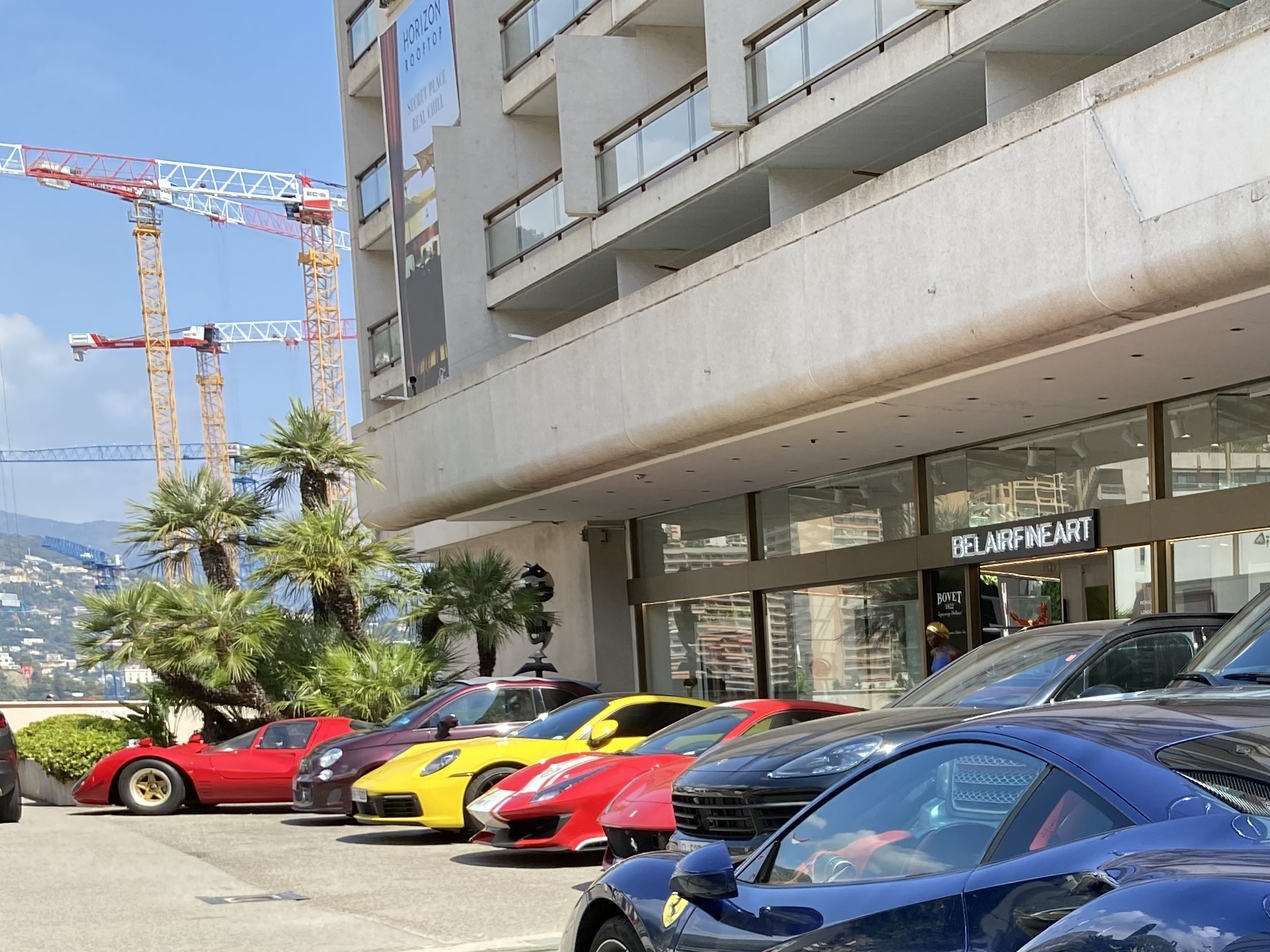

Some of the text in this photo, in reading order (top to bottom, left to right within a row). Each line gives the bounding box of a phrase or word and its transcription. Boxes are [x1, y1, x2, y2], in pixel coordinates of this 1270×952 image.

[403, 0, 442, 52] HORIZON
[405, 26, 442, 72] ROOFTOP
[407, 69, 447, 115] SECRET PLACE
[936, 590, 962, 606] BOVET
